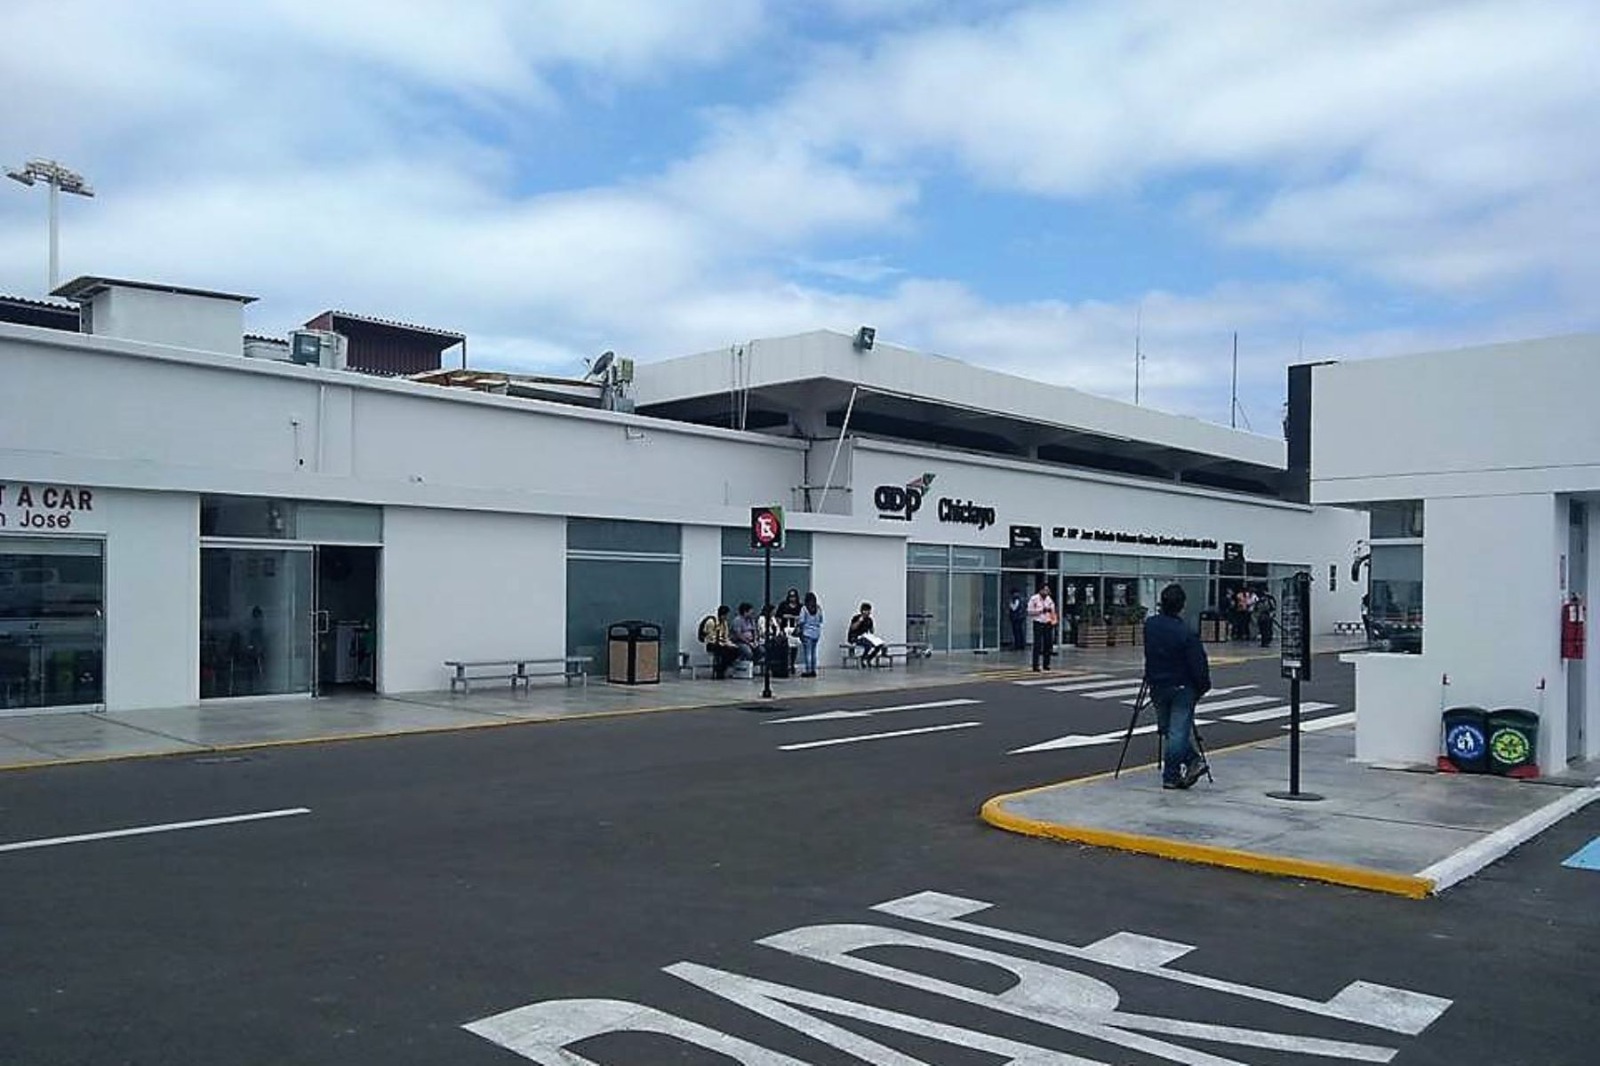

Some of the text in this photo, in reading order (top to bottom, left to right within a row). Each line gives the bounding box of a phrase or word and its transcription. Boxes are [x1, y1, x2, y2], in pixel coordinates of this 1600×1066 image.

[17, 485, 34, 508] A
[42, 487, 93, 511] CAR
[20, 509, 72, 529] José
[938, 497, 997, 530] Chiclayo
